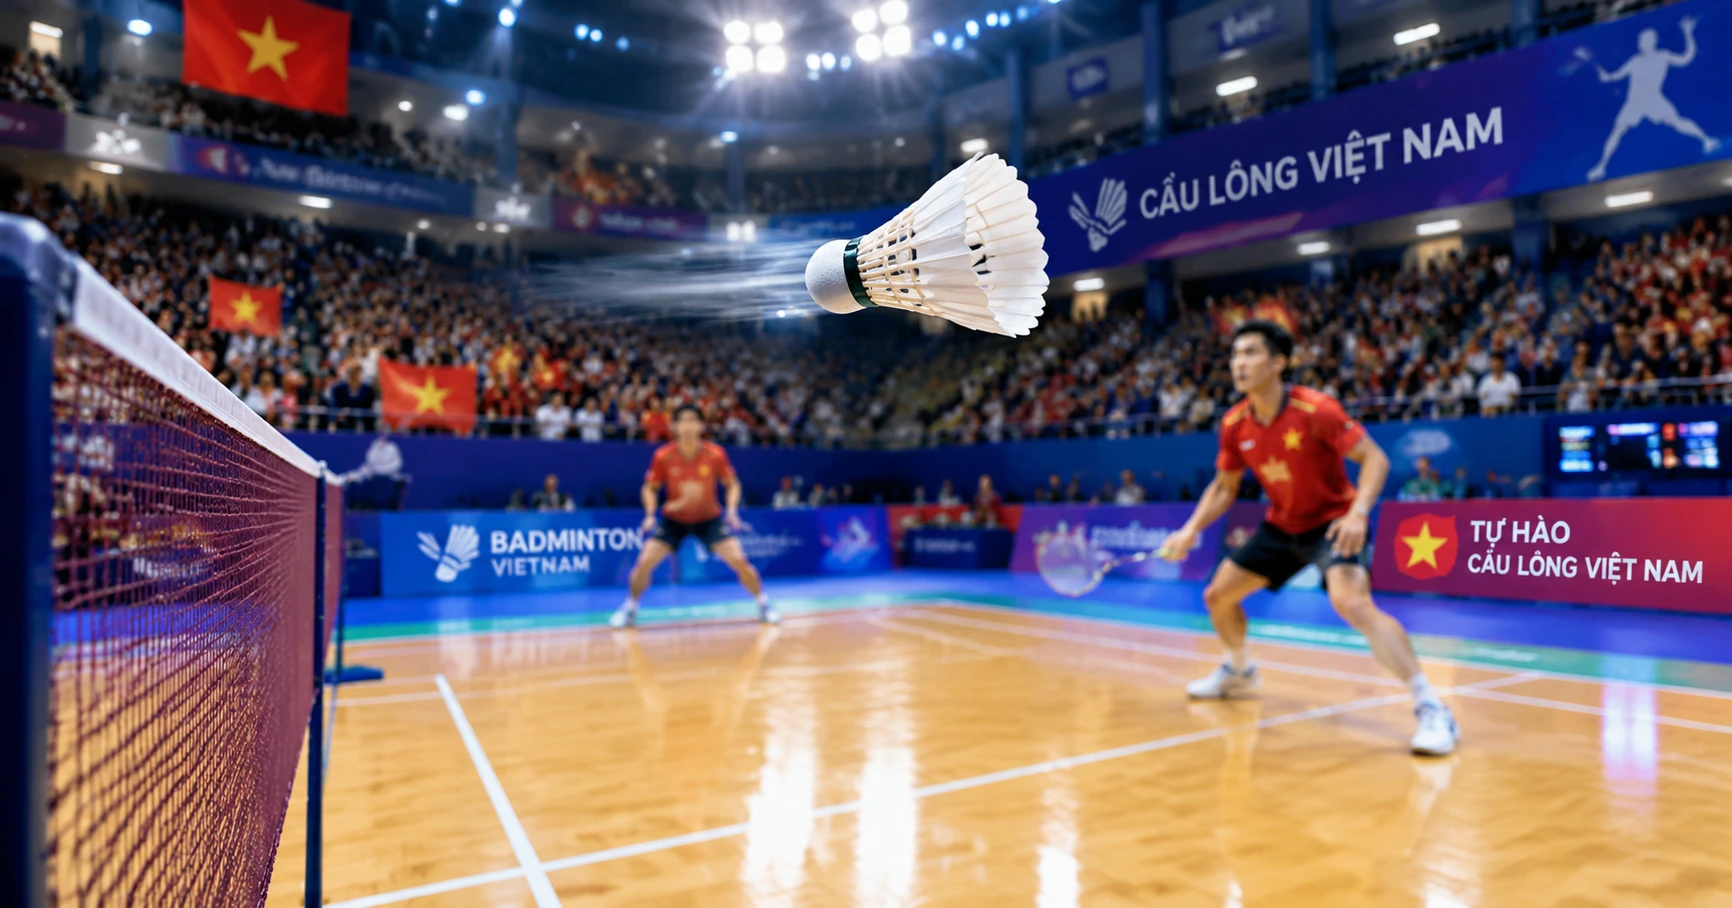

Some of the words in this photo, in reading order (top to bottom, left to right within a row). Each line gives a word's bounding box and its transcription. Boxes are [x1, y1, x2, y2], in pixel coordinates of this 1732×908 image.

[1209, 156, 1299, 206] LÔNG
[1307, 129, 1391, 184] VIỆT
[1402, 106, 1503, 164] NAM
[490, 527, 644, 554] BADMINTON
[1470, 517, 1507, 548] TỰ
[1512, 515, 1571, 544] HÀO
[490, 554, 590, 578] VIETNAM
[1517, 550, 1578, 578] LÔNG
[1585, 551, 1638, 586] VIỆT
[1643, 558, 1703, 584] NAM
